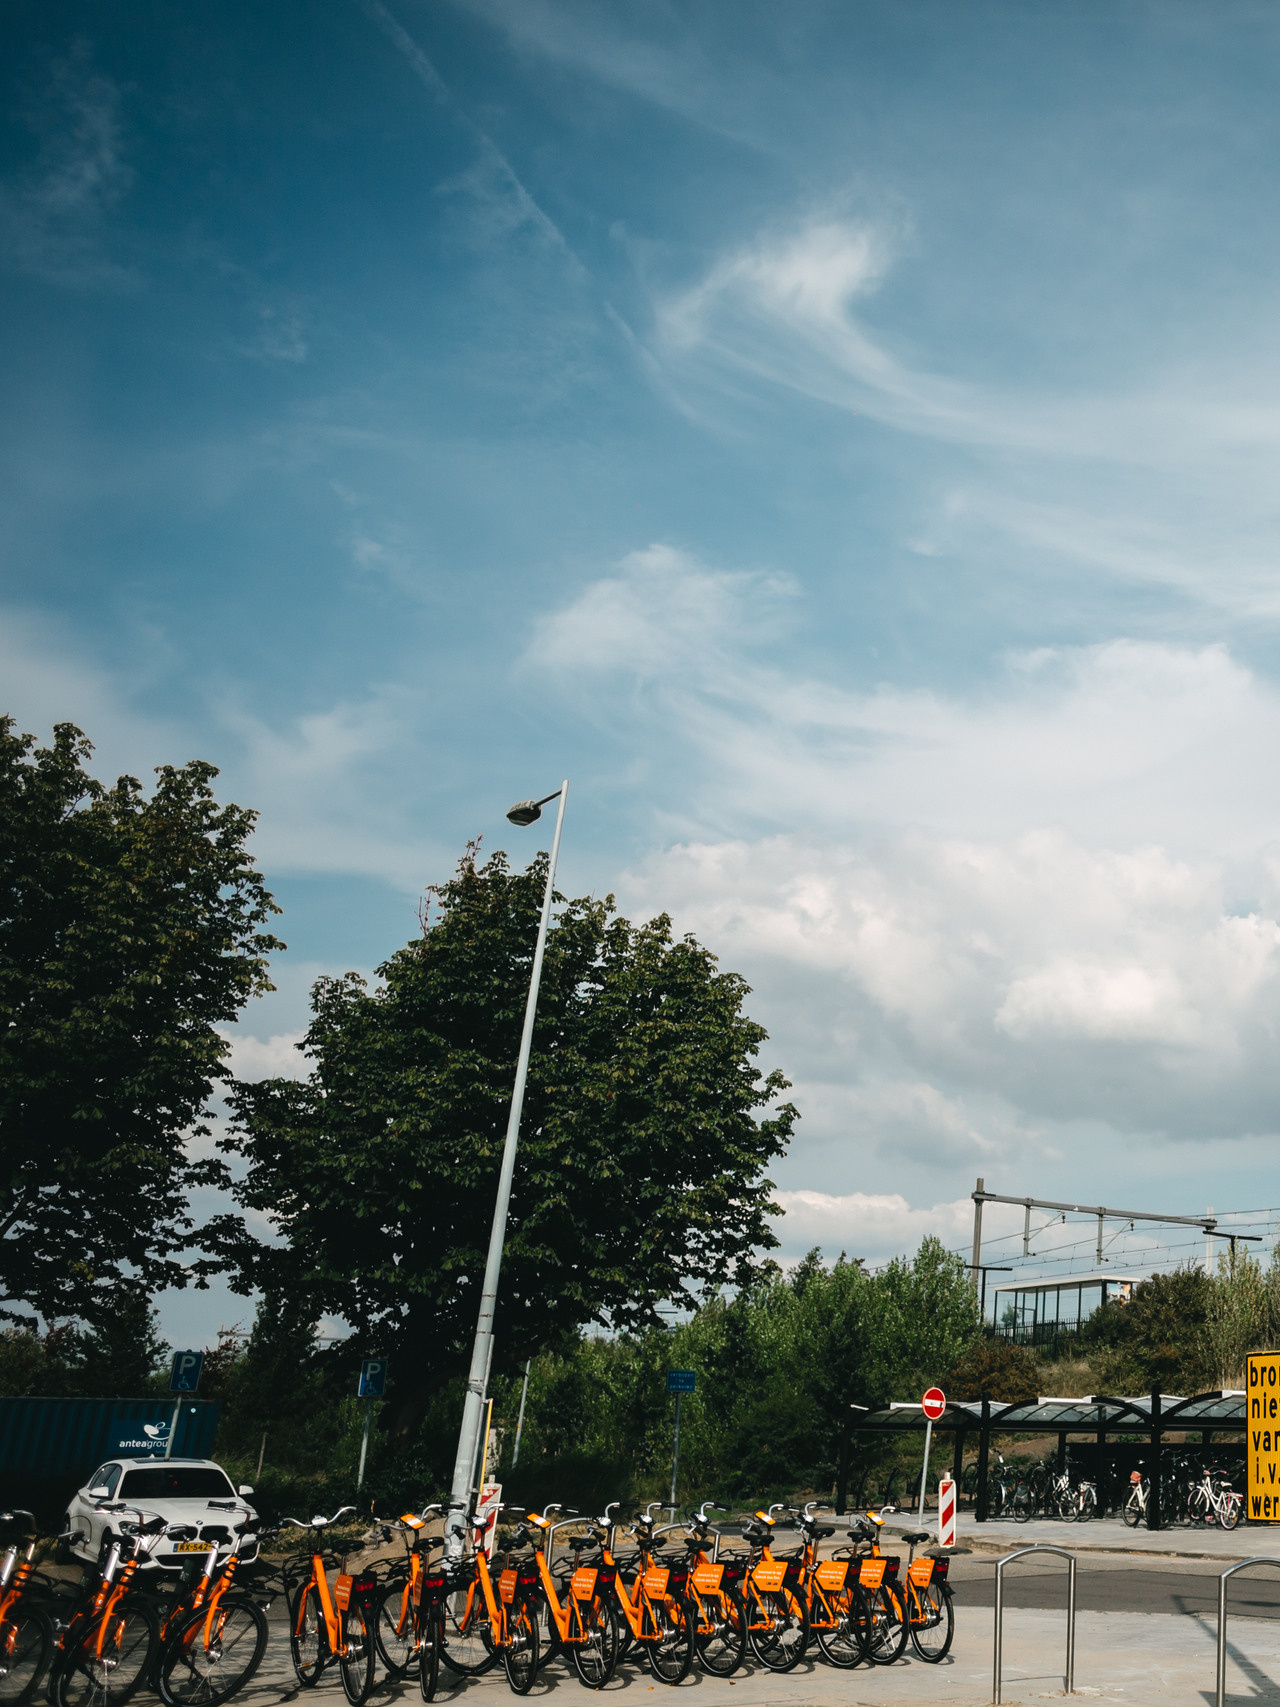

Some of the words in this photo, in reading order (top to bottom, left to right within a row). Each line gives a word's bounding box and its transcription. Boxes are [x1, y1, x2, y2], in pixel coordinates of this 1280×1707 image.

[179, 1355, 196, 1375] P
[366, 1362, 381, 1381] P
[119, 1440, 168, 1449] anteagrou
